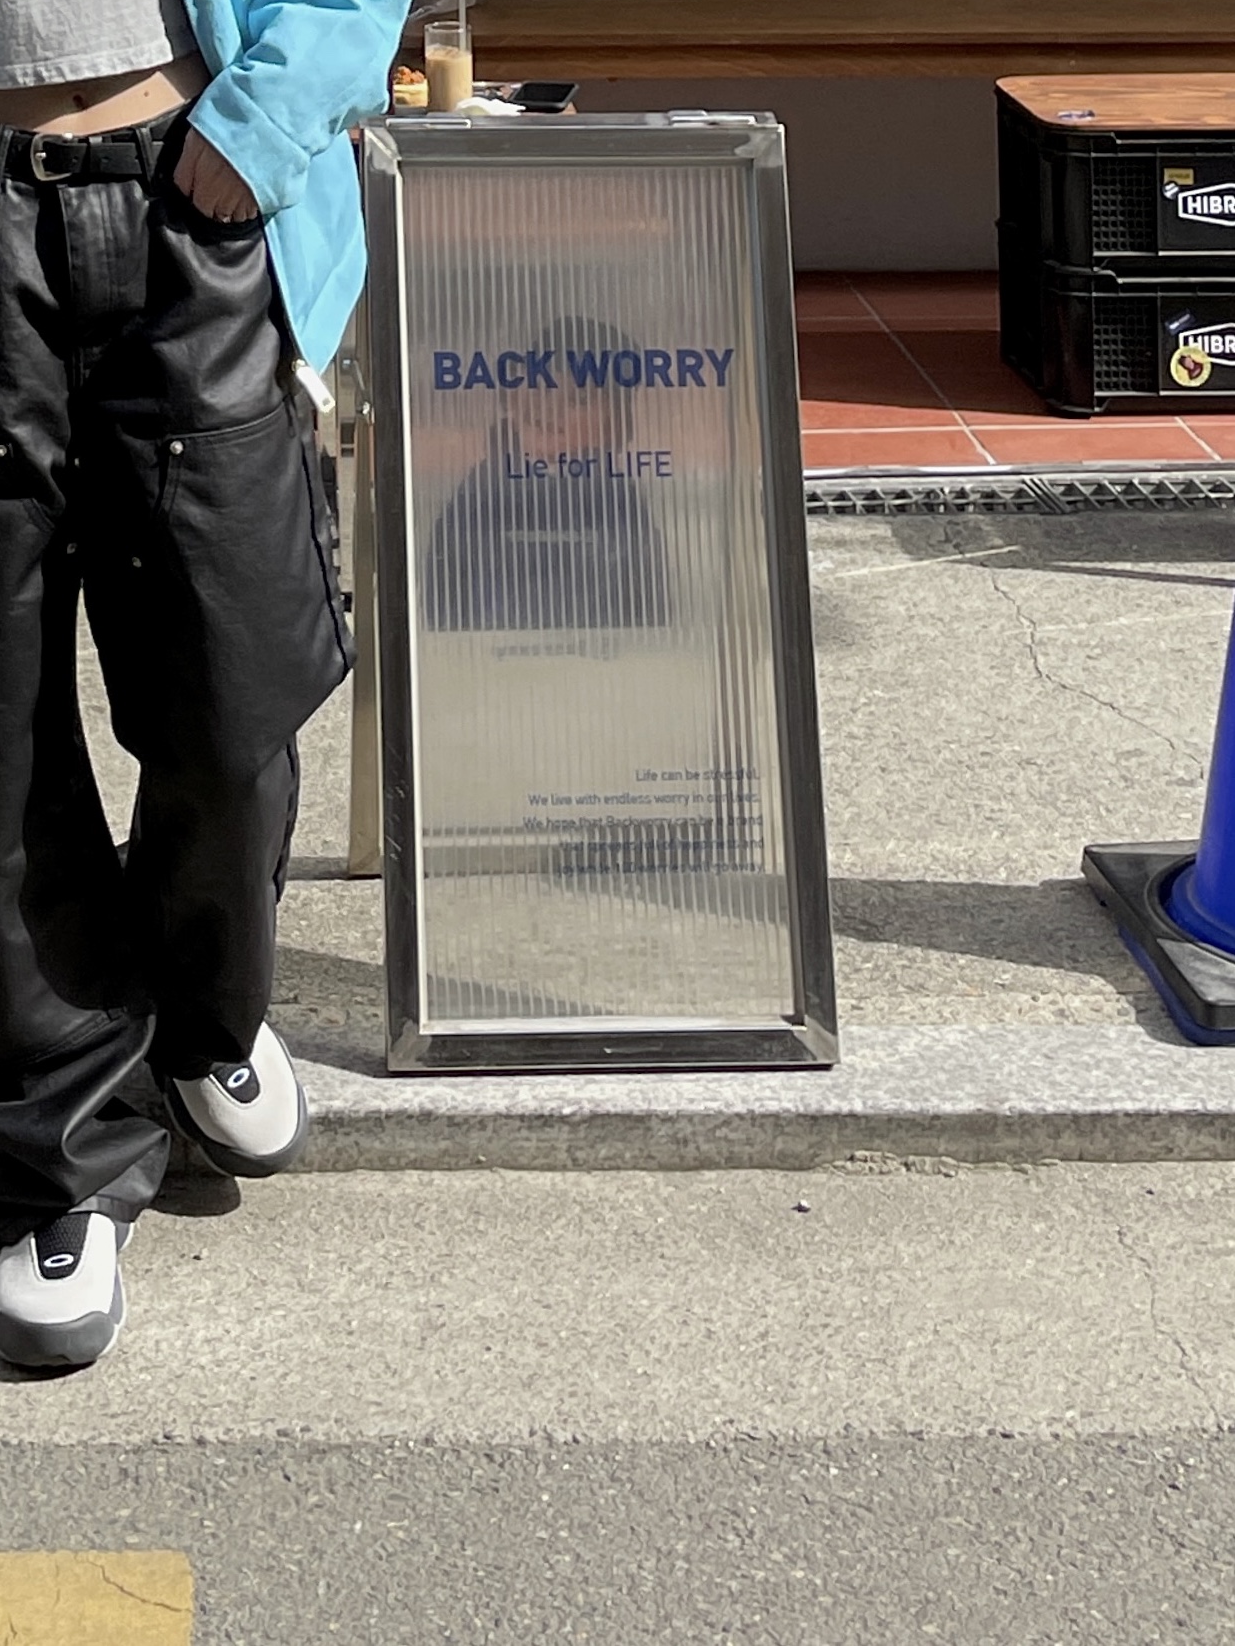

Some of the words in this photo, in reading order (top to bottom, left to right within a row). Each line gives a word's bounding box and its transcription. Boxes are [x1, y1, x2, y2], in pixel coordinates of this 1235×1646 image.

[433, 349, 559, 390] BACK
[565, 348, 735, 389] WORRY
[506, 451, 548, 479] Lie
[557, 451, 598, 478] for
[608, 450, 673, 478] LIFE
[635, 769, 658, 782] Life
[661, 770, 683, 781] can
[685, 768, 701, 781] be
[528, 793, 548, 806] We
[551, 794, 572, 806] live
[575, 794, 601, 805] with
[603, 793, 652, 805] endless
[655, 794, 689, 807] worry
[692, 793, 704, 804] in
